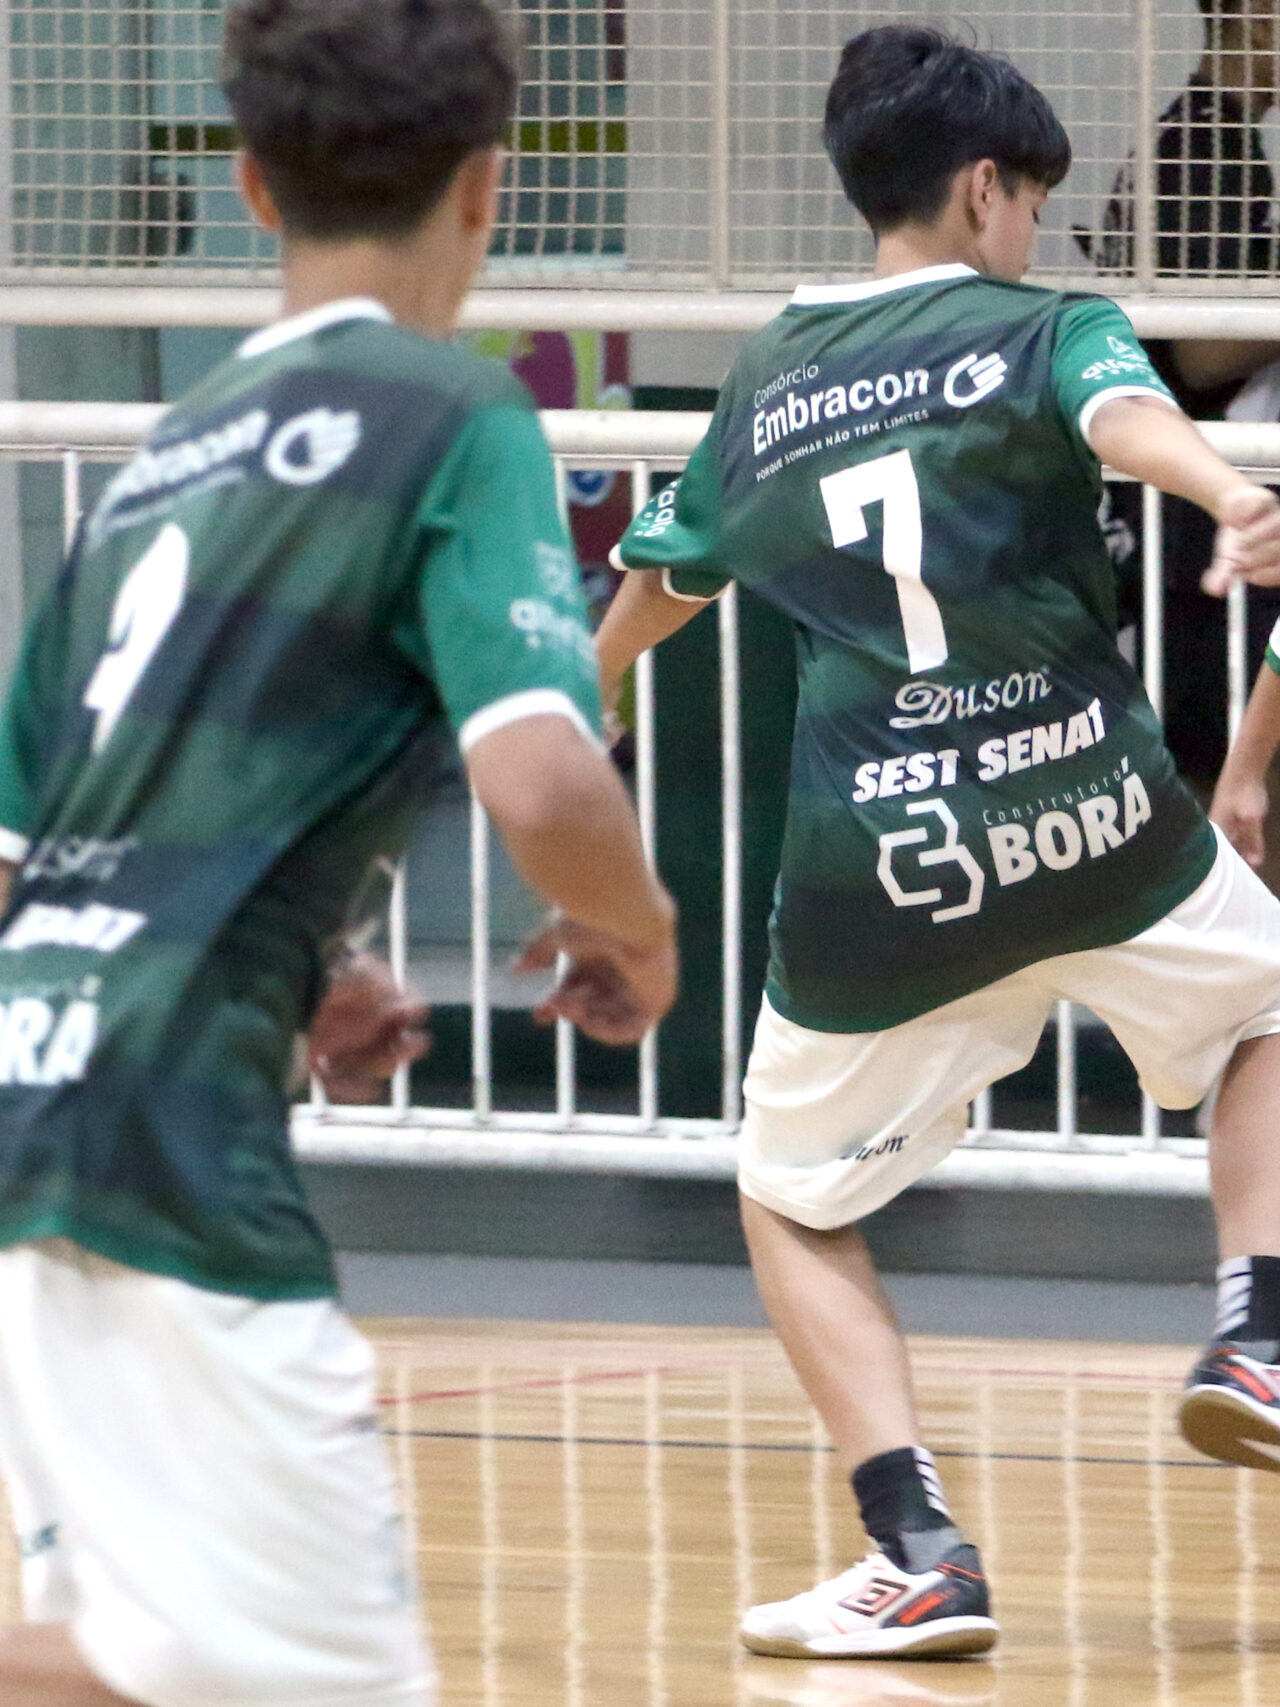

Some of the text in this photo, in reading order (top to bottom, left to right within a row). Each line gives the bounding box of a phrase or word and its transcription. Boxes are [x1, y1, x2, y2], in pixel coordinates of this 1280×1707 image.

[753, 369, 930, 456] Embracon
[754, 363, 819, 409] Consórcio
[755, 457, 784, 482] PORQUE
[784, 439, 823, 465] SONHAR
[854, 422, 880, 439] TEM
[884, 409, 929, 430] LIMITES
[819, 448, 948, 674] 7
[888, 671, 1052, 729] Duson
[852, 697, 1106, 804] SEST SENAT
[983, 770, 1121, 826] Construtora
[987, 756, 1152, 887] BORÁ
